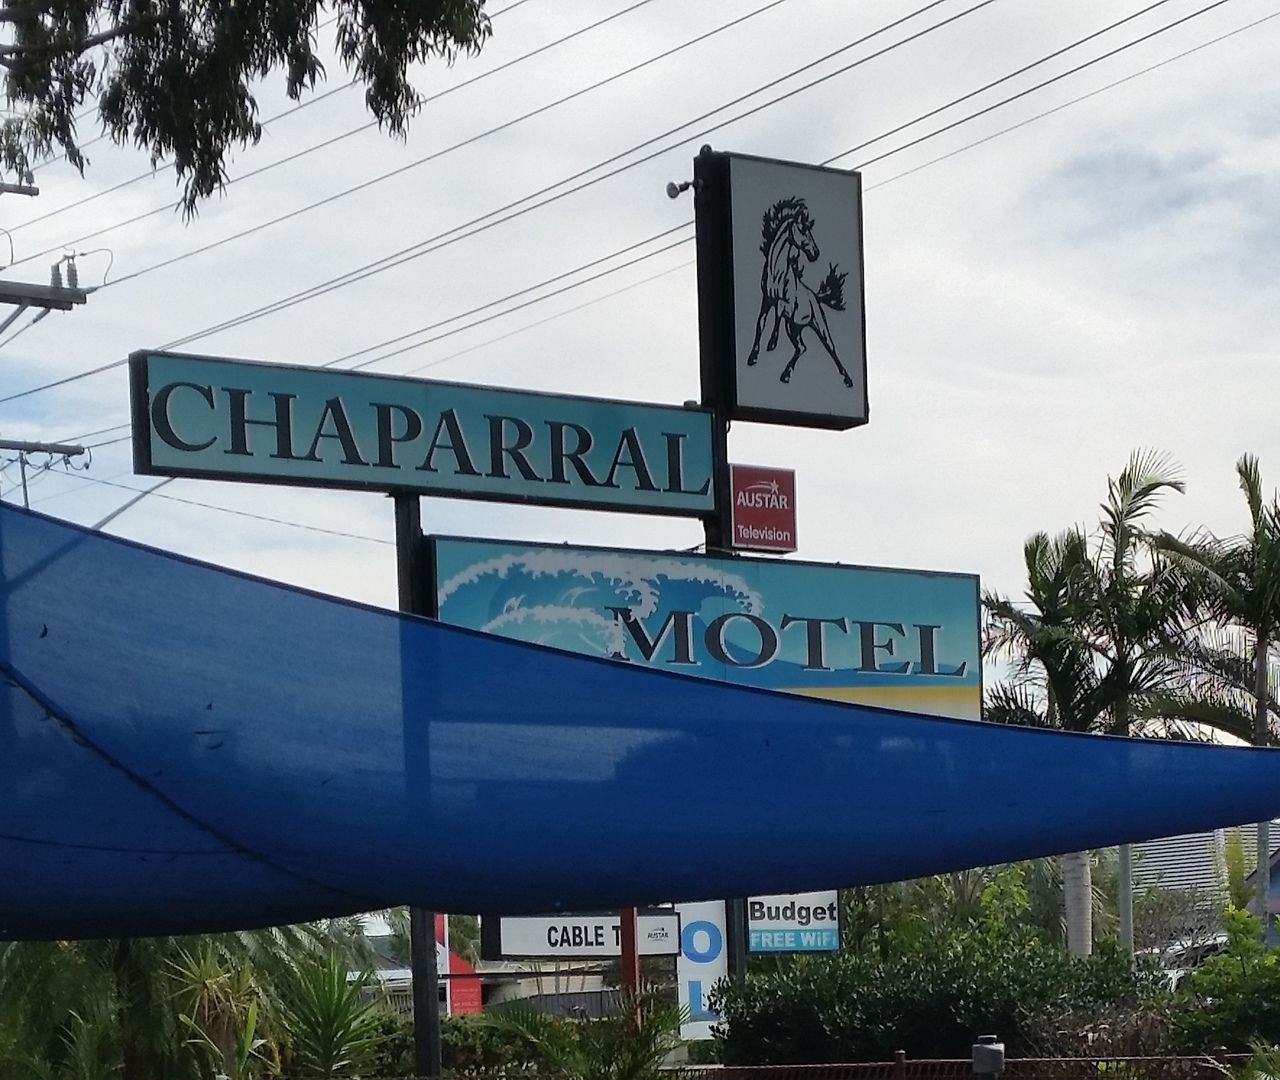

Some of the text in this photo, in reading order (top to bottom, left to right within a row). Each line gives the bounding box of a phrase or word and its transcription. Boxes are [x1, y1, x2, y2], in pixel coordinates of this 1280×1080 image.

[150, 380, 711, 496] CHAPARRAL
[736, 490, 788, 510] AUSTAR
[737, 525, 791, 541] Television
[604, 606, 967, 678] MOTEL
[749, 900, 837, 926] Budget
[547, 925, 605, 948] CABLE
[751, 932, 796, 948] FREE
